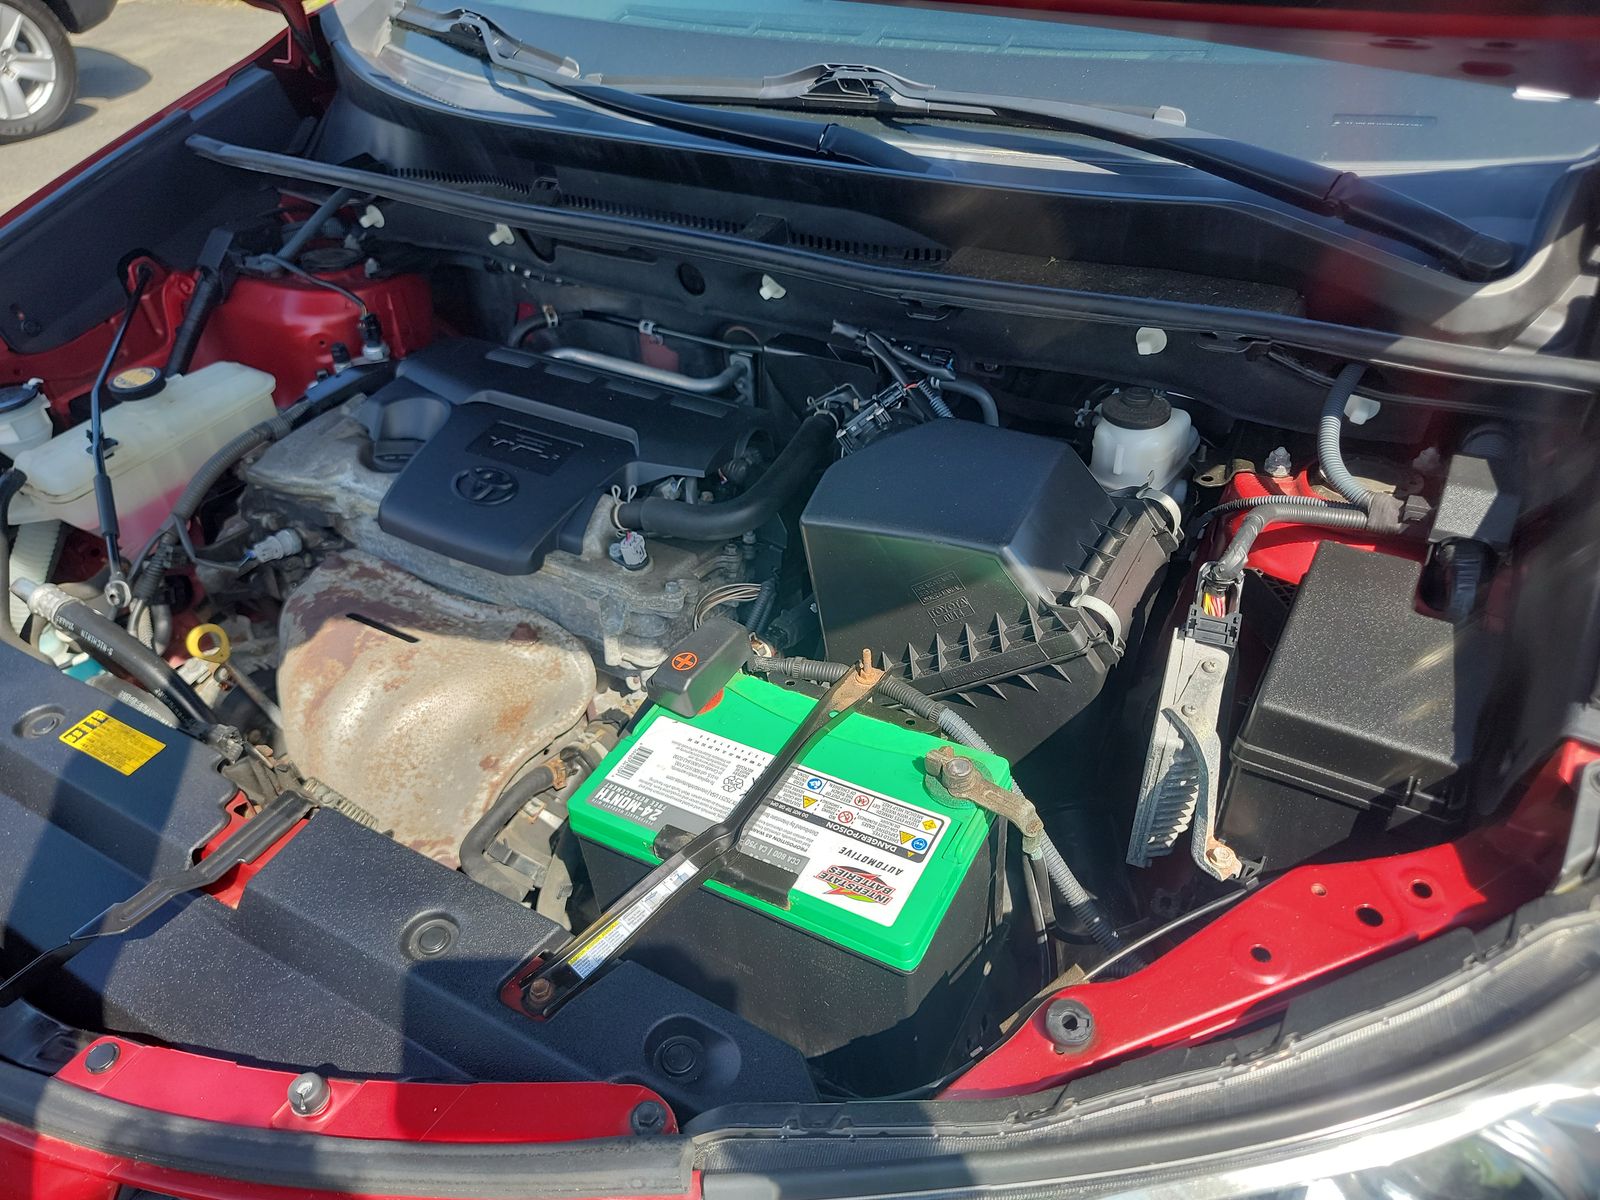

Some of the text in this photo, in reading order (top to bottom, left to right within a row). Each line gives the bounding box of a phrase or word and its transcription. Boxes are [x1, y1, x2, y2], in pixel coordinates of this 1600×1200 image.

[930, 596, 970, 618] TOYOTA
[604, 782, 649, 803] REPLACEMENT
[594, 787, 663, 821] 24-MONTH
[743, 838, 760, 849] 750
[757, 843, 768, 852] CA
[825, 821, 898, 852] DANGER/POISON
[772, 849, 787, 860] 600
[785, 854, 801, 865] CCA
[837, 846, 903, 876] AUTOMOTIVE
[817, 871, 889, 904] INTERSTATE
[827, 865, 892, 895] BATTERIES
